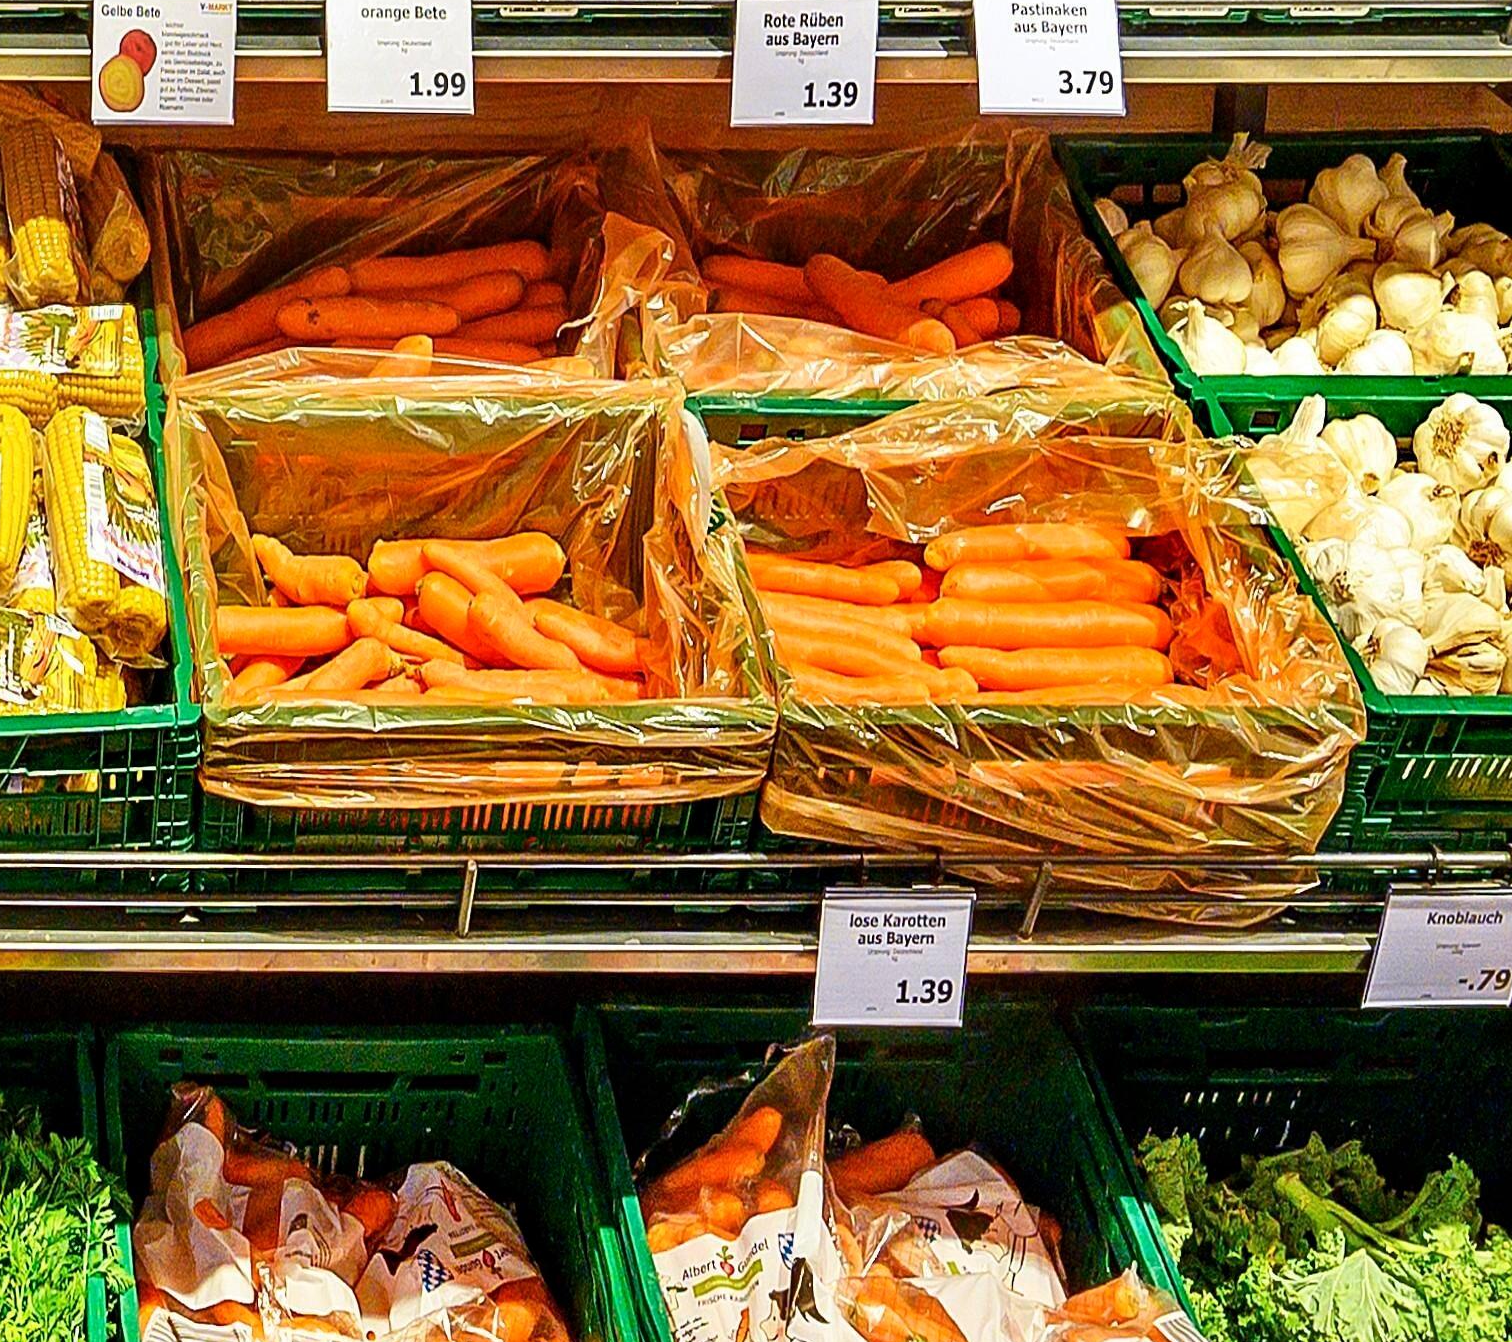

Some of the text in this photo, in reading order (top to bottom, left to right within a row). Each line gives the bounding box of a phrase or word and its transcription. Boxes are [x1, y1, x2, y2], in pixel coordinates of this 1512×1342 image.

[199, 3, 233, 11] V-MARKT
[361, 5, 447, 22] orange Bete
[1011, 2, 1087, 17] Pastinaken
[763, 12, 844, 29] Rote Rüben
[1014, 20, 1088, 37] aus Bayern
[765, 31, 839, 49] aus Bayern
[409, 71, 466, 98] 1.99
[1058, 69, 1114, 95] 3.79
[803, 81, 858, 108] 1.39
[849, 913, 946, 928] lose Karotten
[1426, 909, 1504, 925] Knoblauch
[857, 931, 935, 948] aus Bayern
[1458, 968, 1512, 991] -.79
[895, 979, 954, 1004] 1.39
[682, 1259, 717, 1281] Albert
